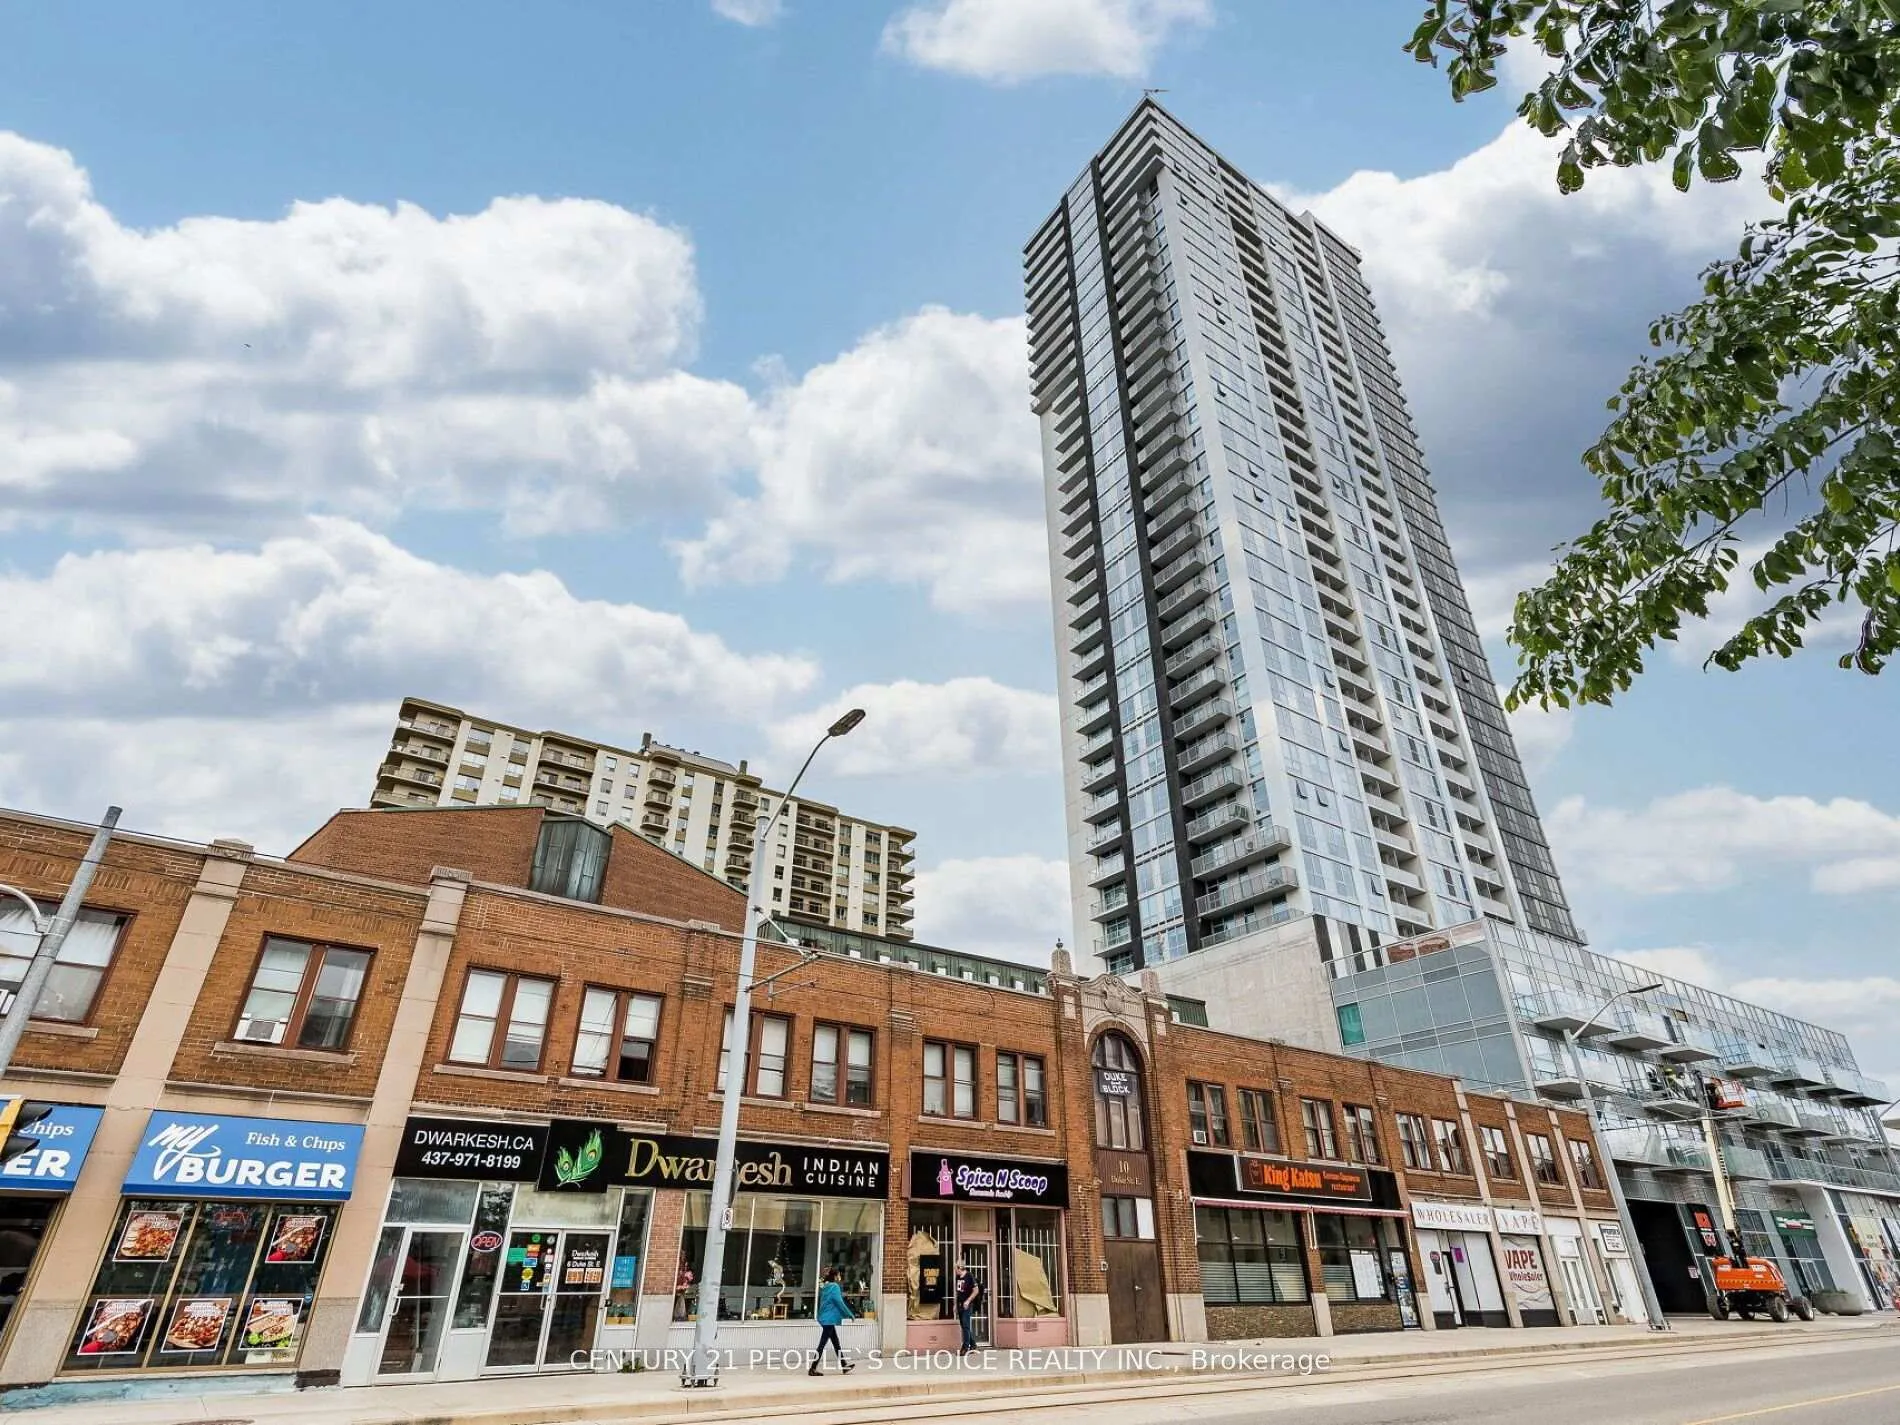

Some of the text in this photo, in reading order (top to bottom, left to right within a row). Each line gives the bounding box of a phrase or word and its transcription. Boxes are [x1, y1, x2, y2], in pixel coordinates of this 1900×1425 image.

[1103, 1072, 1128, 1081] DUKE
[1102, 1085, 1131, 1094] BLOCK
[245, 1132, 345, 1151] Fish & Chips
[414, 1130, 534, 1151] DWARKESH.CA
[421, 1151, 521, 1169] 437-971-8199
[624, 1138, 793, 1187] Dwaresh
[803, 1157, 879, 1175] INDIAN
[1119, 1160, 1129, 1173] 10
[175, 1156, 347, 1189] BURGER
[805, 1173, 876, 1188] CUISINE
[956, 1165, 1048, 1196] Spice N Scoop
[1263, 1164, 1291, 1192] King
[1291, 1167, 1323, 1189] Katsu
[1501, 1213, 1540, 1229] VAPE
[473, 1236, 501, 1248] OPEN
[1503, 1249, 1538, 1269] VAPE
